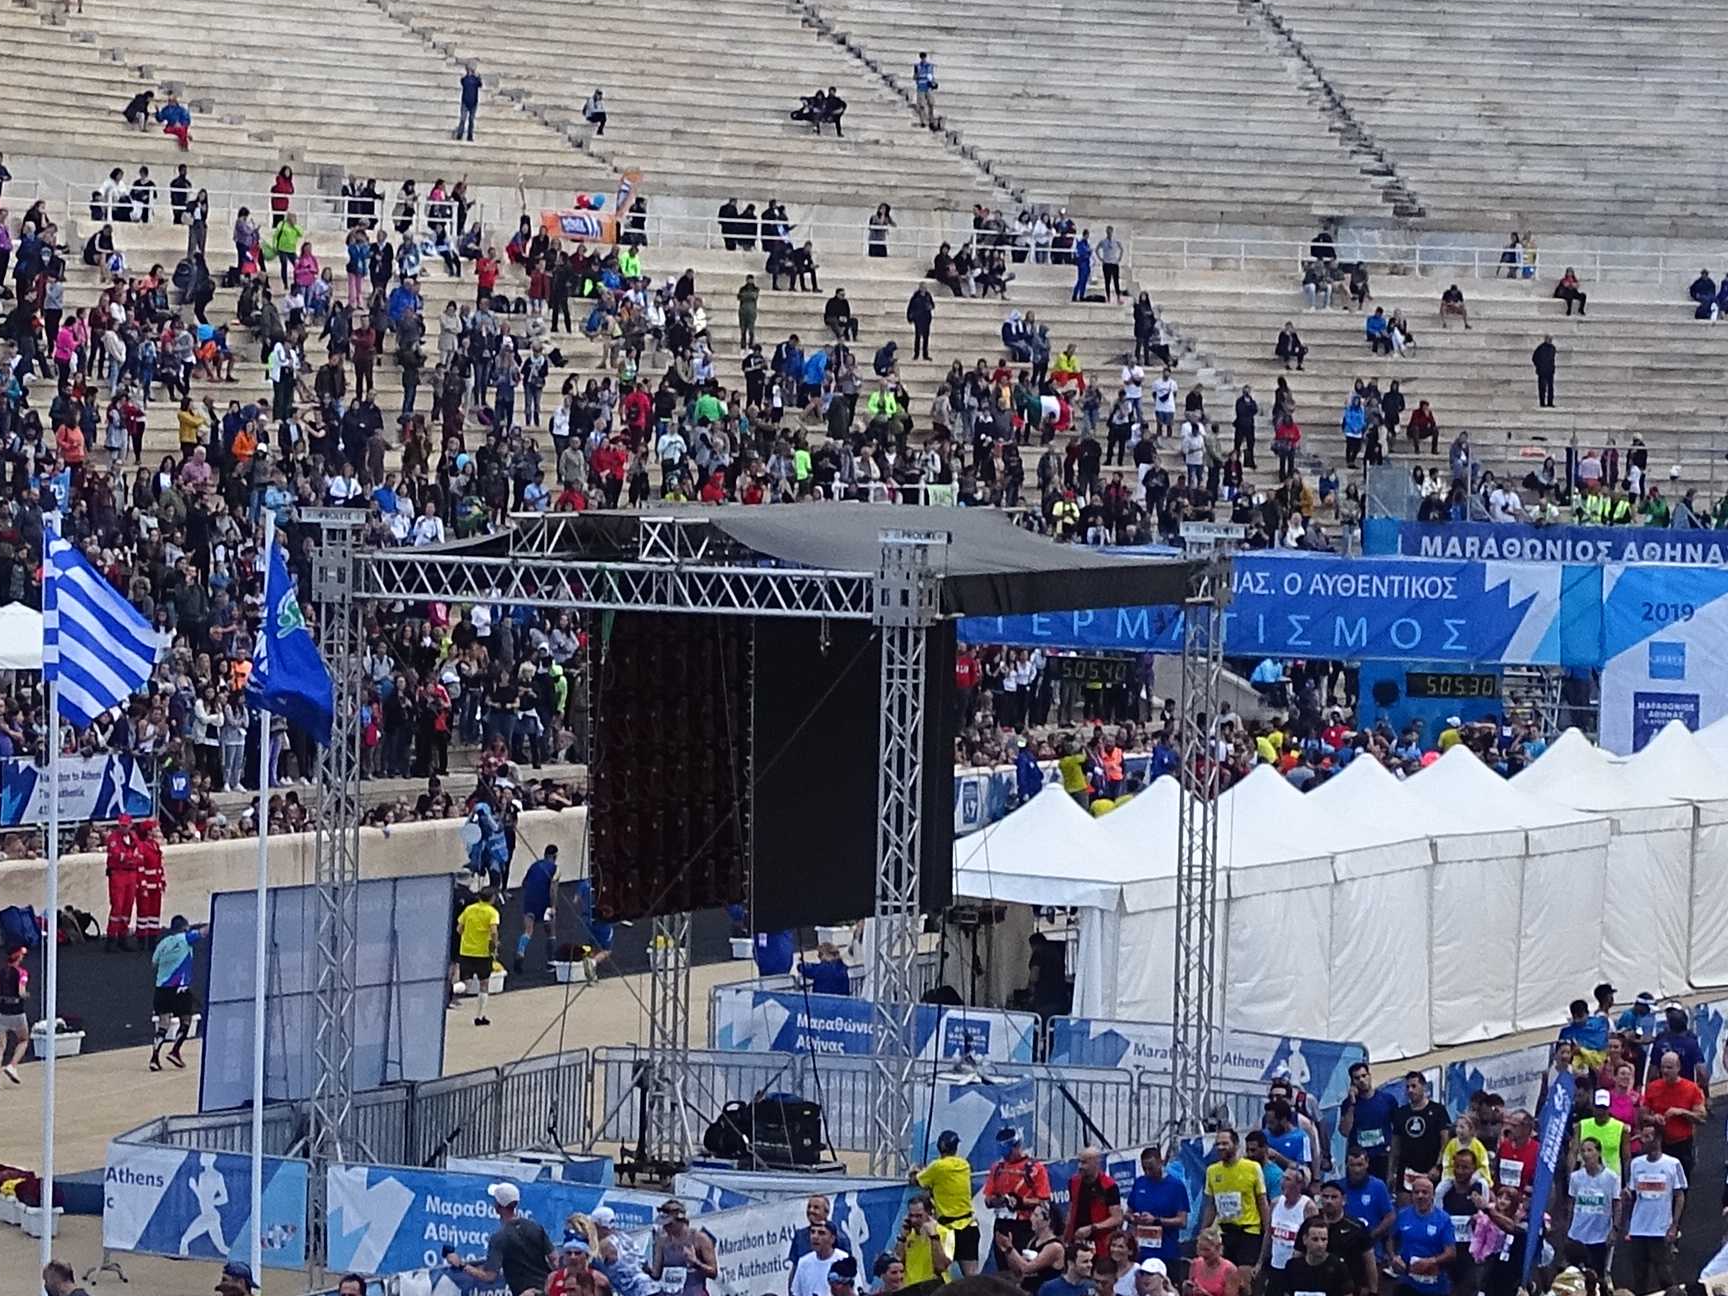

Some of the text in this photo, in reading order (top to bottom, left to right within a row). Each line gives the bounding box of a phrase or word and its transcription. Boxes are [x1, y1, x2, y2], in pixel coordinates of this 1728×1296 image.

[1420, 535, 1612, 563] ΜΑΡΑΘΩΝΙΟΣ
[1284, 572, 1303, 596] Ο
[1309, 573, 1458, 600] ΑΥΘΕΝΤΙΚΟΣ
[1641, 601, 1695, 624] 2019
[1221, 1050, 1265, 1070] Athens
[105, 1166, 165, 1188] Athens
[423, 1221, 491, 1250] Αθήνας
[718, 1229, 767, 1255] Marathon
[767, 1231, 779, 1246] to
[737, 1254, 790, 1278] Authentic
